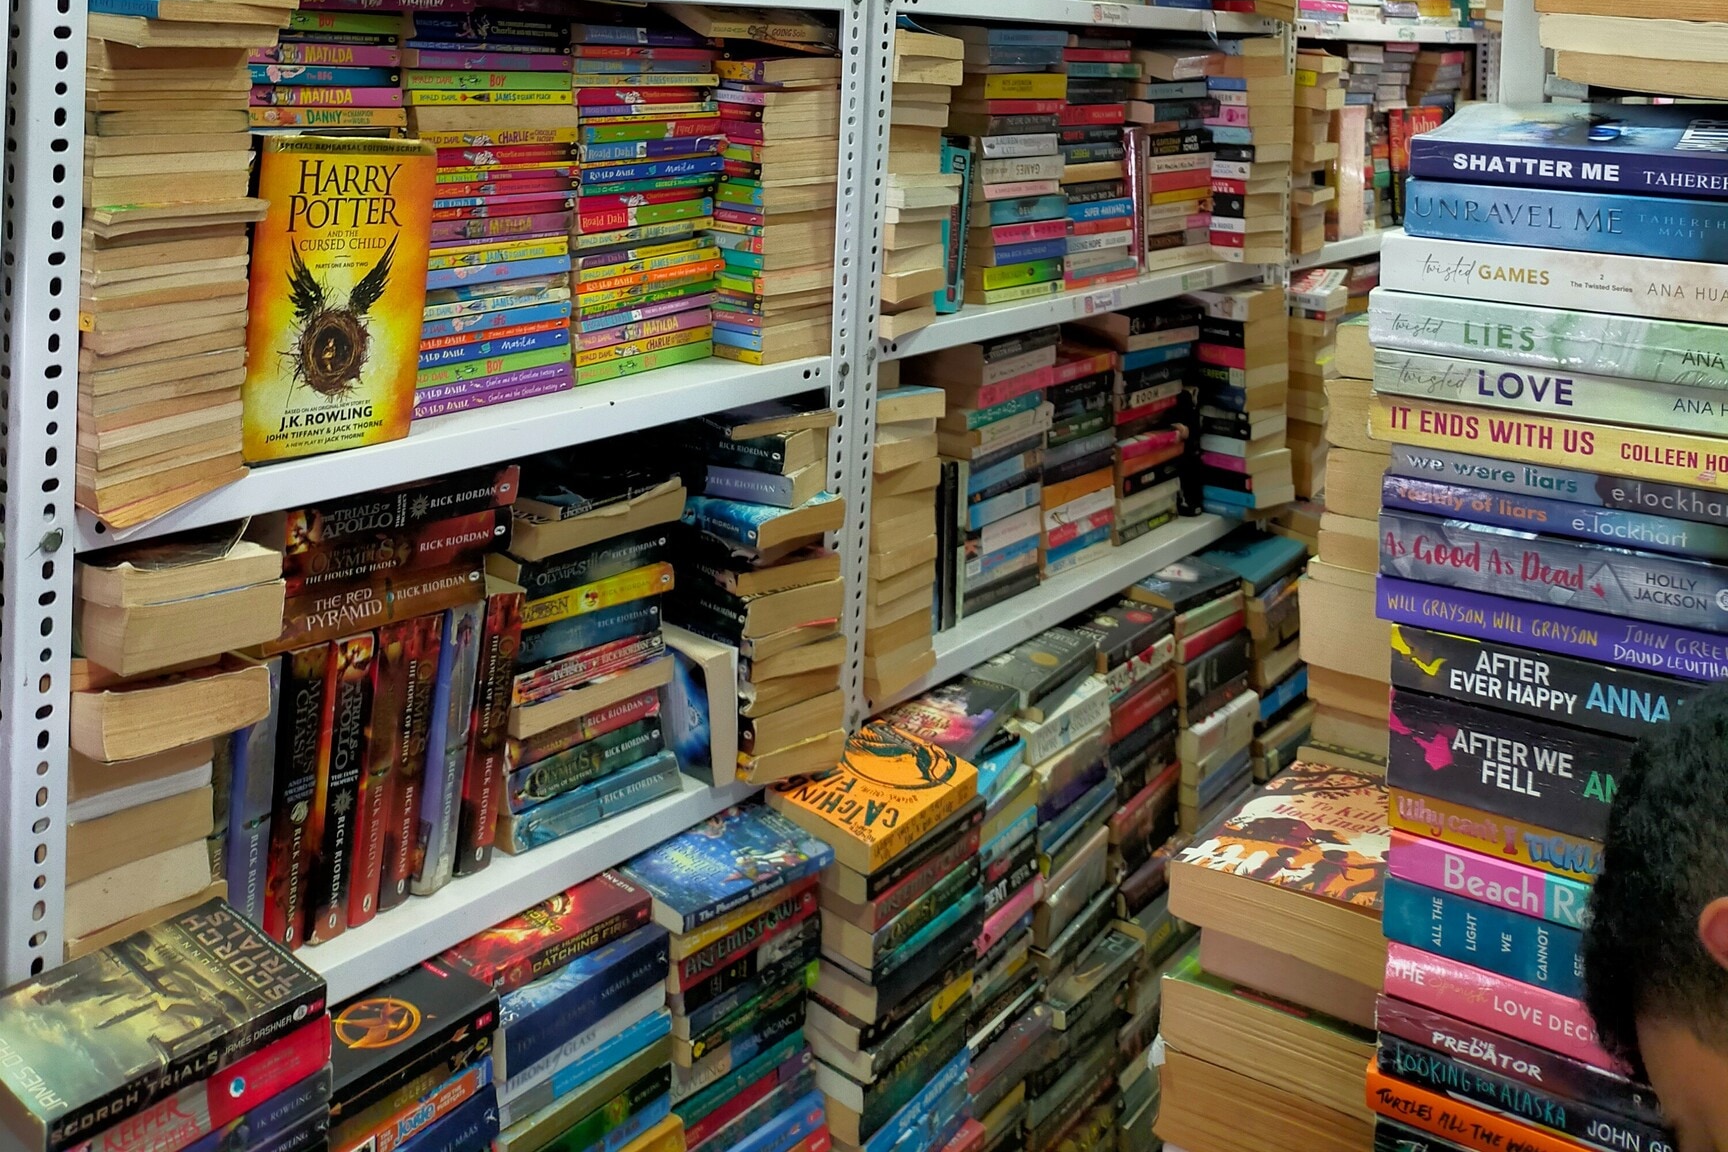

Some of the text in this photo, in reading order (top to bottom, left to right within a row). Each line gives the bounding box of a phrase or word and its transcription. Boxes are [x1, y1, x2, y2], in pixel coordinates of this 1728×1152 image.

[305, 47, 353, 63] MATILDA
[490, 74, 507, 87] BOY
[306, 110, 342, 124] DANNY
[316, 143, 360, 151] REHEARSAL
[298, 160, 402, 196] HARRY
[1453, 153, 1619, 181] SHATTER ME
[286, 195, 402, 232] POTTER
[1413, 197, 1623, 234] UNRAVEL ME
[1638, 214, 1726, 230] TAHEREH
[300, 238, 386, 251] CURSED CHILD
[1659, 228, 1704, 239] MAFI
[1417, 254, 1550, 285] twisted GAMES
[1570, 281, 1582, 289] The
[1584, 282, 1609, 290] Twisted
[1648, 284, 1684, 298] ANA
[501, 338, 536, 350] Matilda
[1390, 314, 1535, 351] twisted LIES
[1683, 351, 1724, 367] ANA
[1136, 388, 1160, 405] ROOM
[1398, 359, 1573, 406] twisted LOVE
[305, 406, 372, 424] ROWLING
[266, 433, 288, 443] JOHN
[290, 428, 324, 440] TIFFANY
[333, 425, 351, 434] JACK
[354, 420, 383, 430] THORNE
[1391, 406, 1698, 468] IT ENDS WITH US COLLEEN
[1406, 453, 1577, 493] we were liars
[430, 486, 497, 508] RICK RIORDAN
[1572, 514, 1688, 548] e.lockhart
[305, 560, 397, 585] THE HOUSE OF HADES
[1385, 532, 1584, 589] As Good As Dead
[397, 576, 465, 600] RICK RIORDAN
[1646, 572, 1697, 592] HOLLY
[315, 588, 372, 611] THE RED
[1634, 587, 1707, 610] JACKSON
[306, 600, 382, 631] PYRAMID
[1387, 594, 1598, 647] WILL GRAYSON, WILL GRAYSON
[1475, 650, 1550, 685] AFTER
[1450, 669, 1577, 714] EVER HAPPY
[1585, 682, 1670, 723] ANNA
[1452, 731, 1573, 778] AFTER WE
[1481, 760, 1541, 798] FELL
[1311, 802, 1386, 822] To Kill
[329, 817, 346, 919] RICK RIORDAN
[1444, 854, 1539, 917] Beach
[1432, 896, 1444, 919] THE
[533, 919, 629, 973] CATCHING FIRE
[685, 901, 804, 979] ARTEMIS FOWL
[1432, 921, 1442, 947] ALL
[1466, 914, 1477, 952] LIGHT
[1500, 933, 1512, 953] WE
[1536, 927, 1550, 981] CANNOT
[1394, 964, 1425, 985] THE
[1493, 996, 1542, 1026] LOVE
[1432, 1032, 1543, 1081] PREDATOR
[50, 1015, 292, 1142] SCORCH TRIALS JAMES DASHNER
[1395, 1045, 1566, 1127] LOOKING FOR ALASKA
